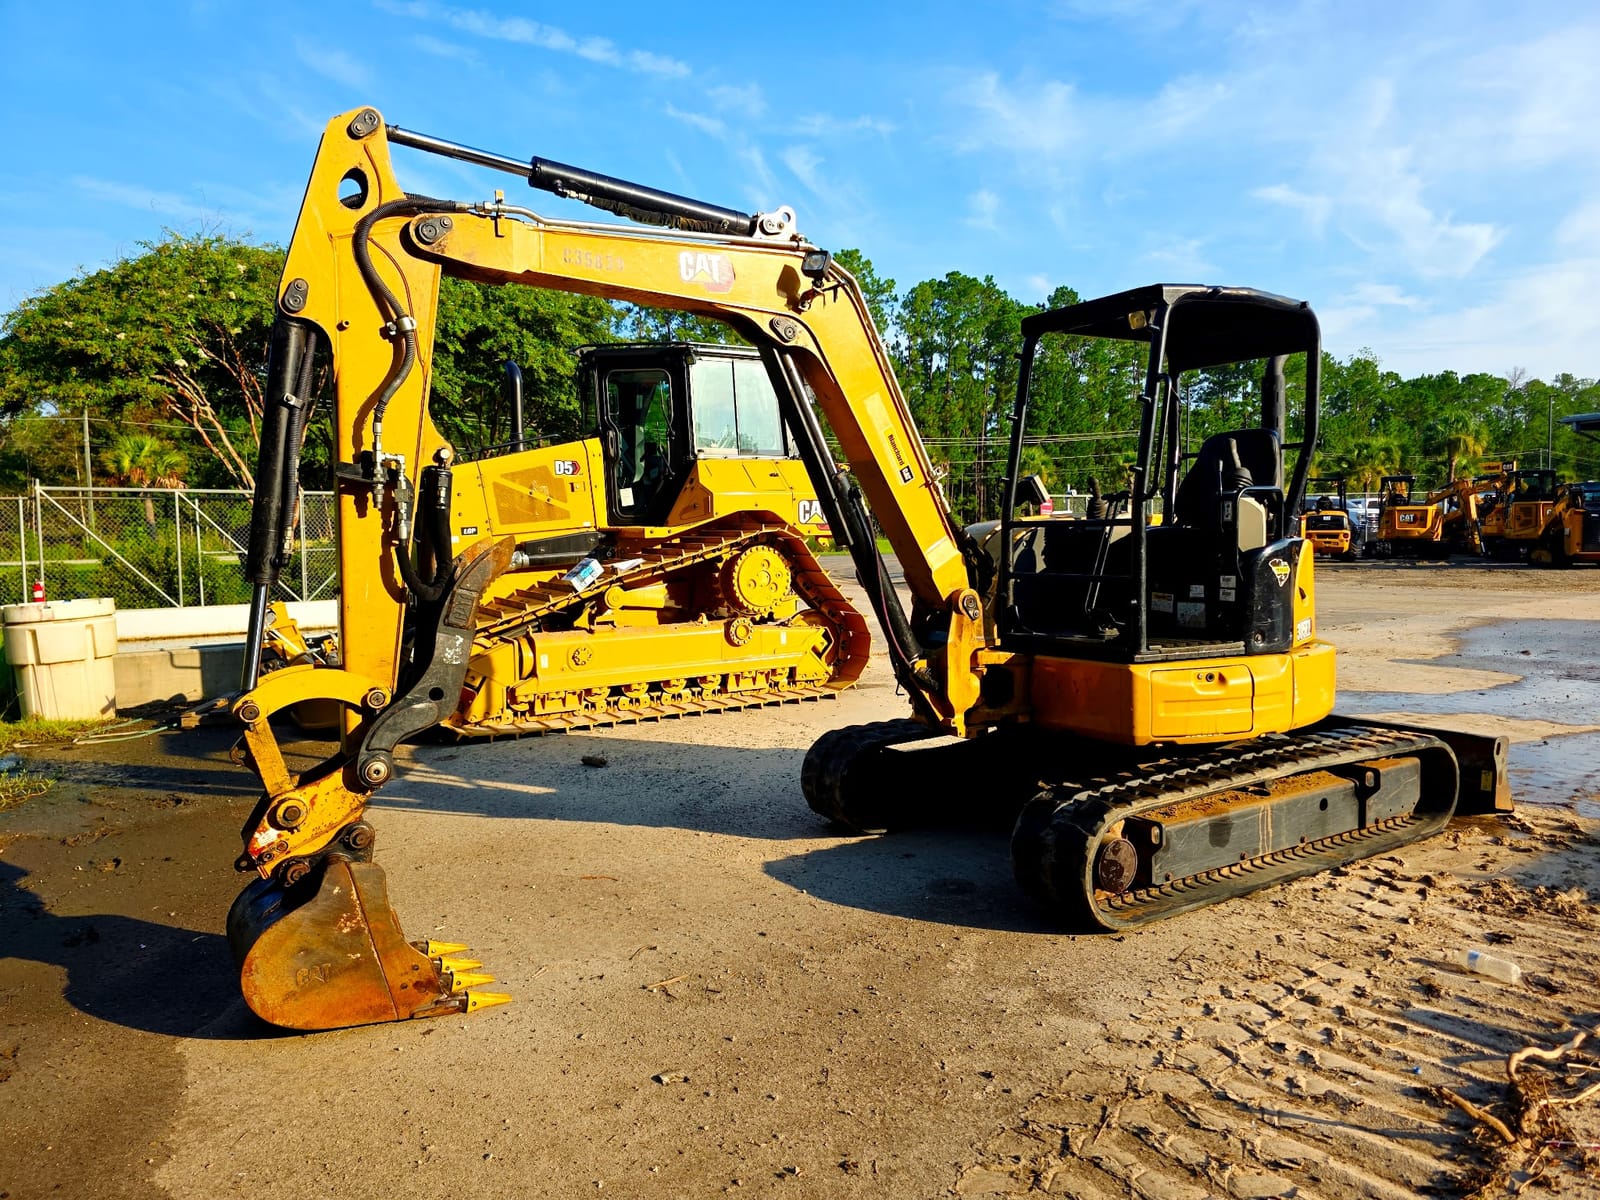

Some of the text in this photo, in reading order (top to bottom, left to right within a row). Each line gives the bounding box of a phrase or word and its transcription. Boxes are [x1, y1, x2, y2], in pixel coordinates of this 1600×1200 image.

[679, 251, 722, 284] CAT
[888, 434, 905, 466] Blanchard
[554, 460, 573, 475] D5
[798, 500, 828, 524] CA
[1399, 513, 1414, 523] CAT
[463, 527, 477, 535] LGP
